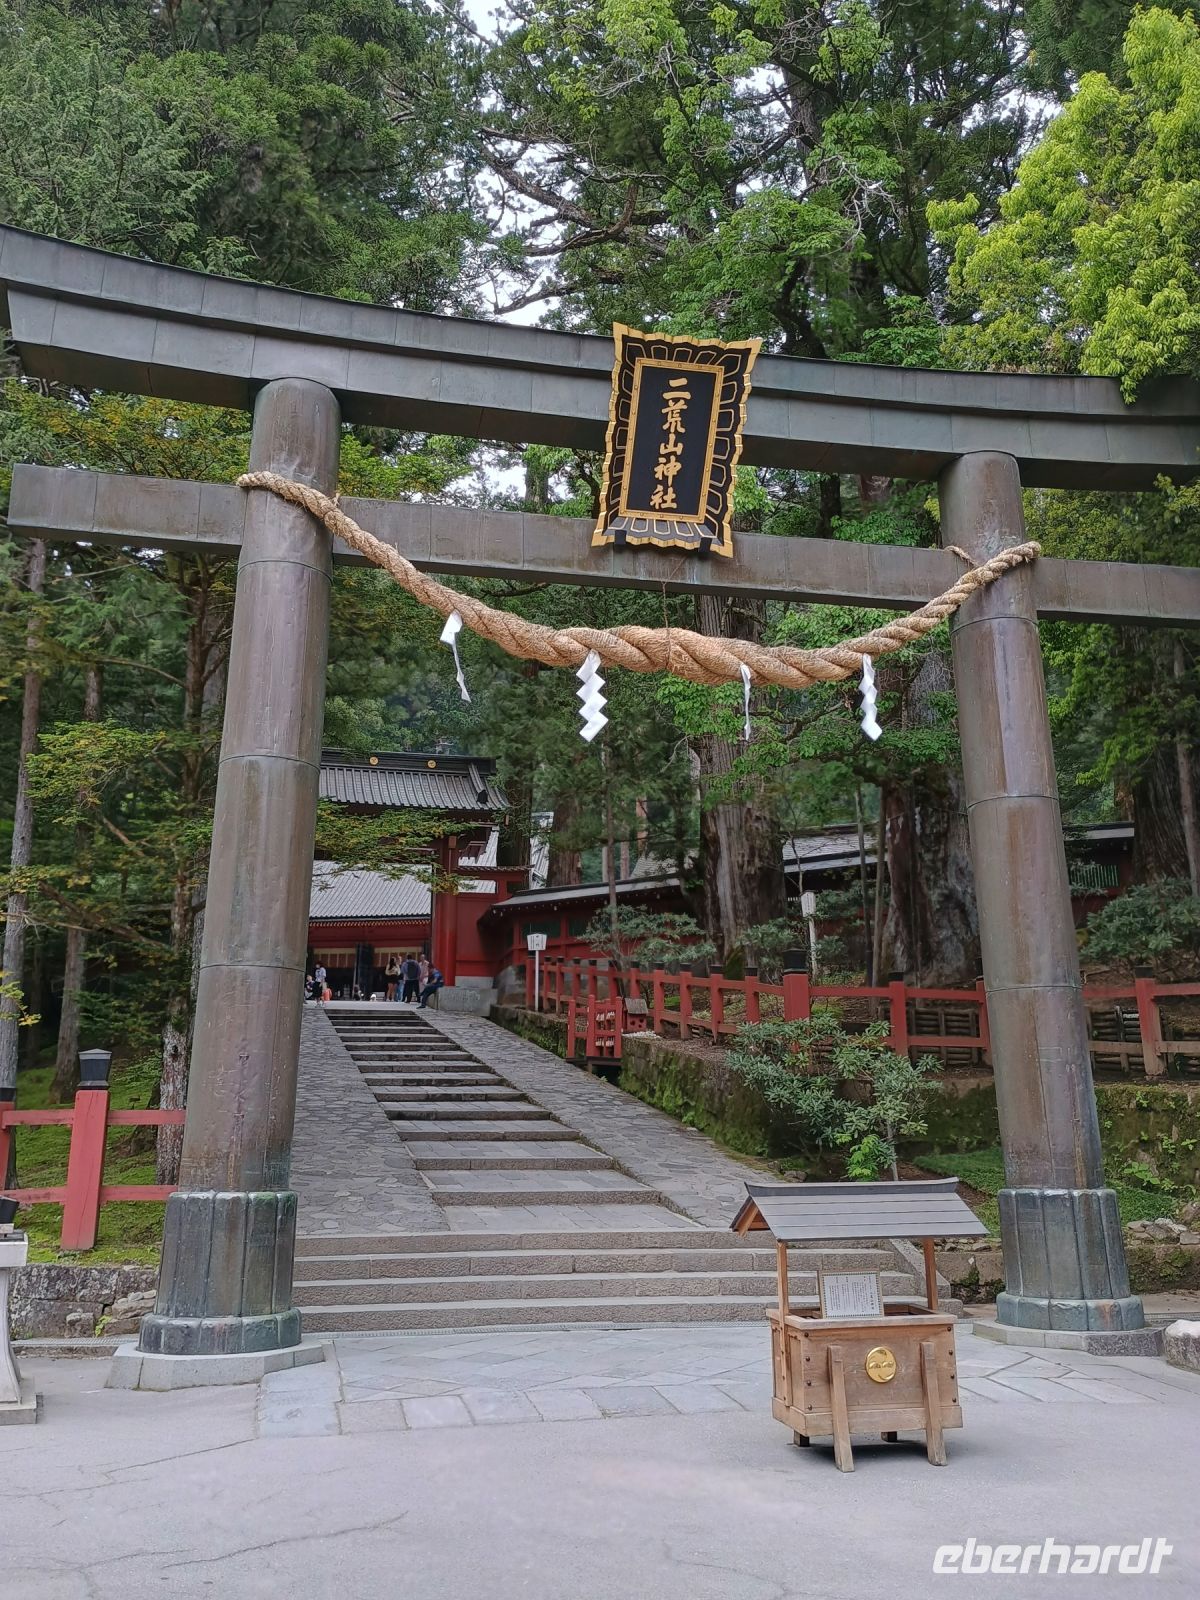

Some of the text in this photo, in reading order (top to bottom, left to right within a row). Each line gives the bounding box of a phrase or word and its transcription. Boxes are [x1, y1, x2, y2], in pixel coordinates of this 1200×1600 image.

[650, 377, 692, 509] 二荒山神社
